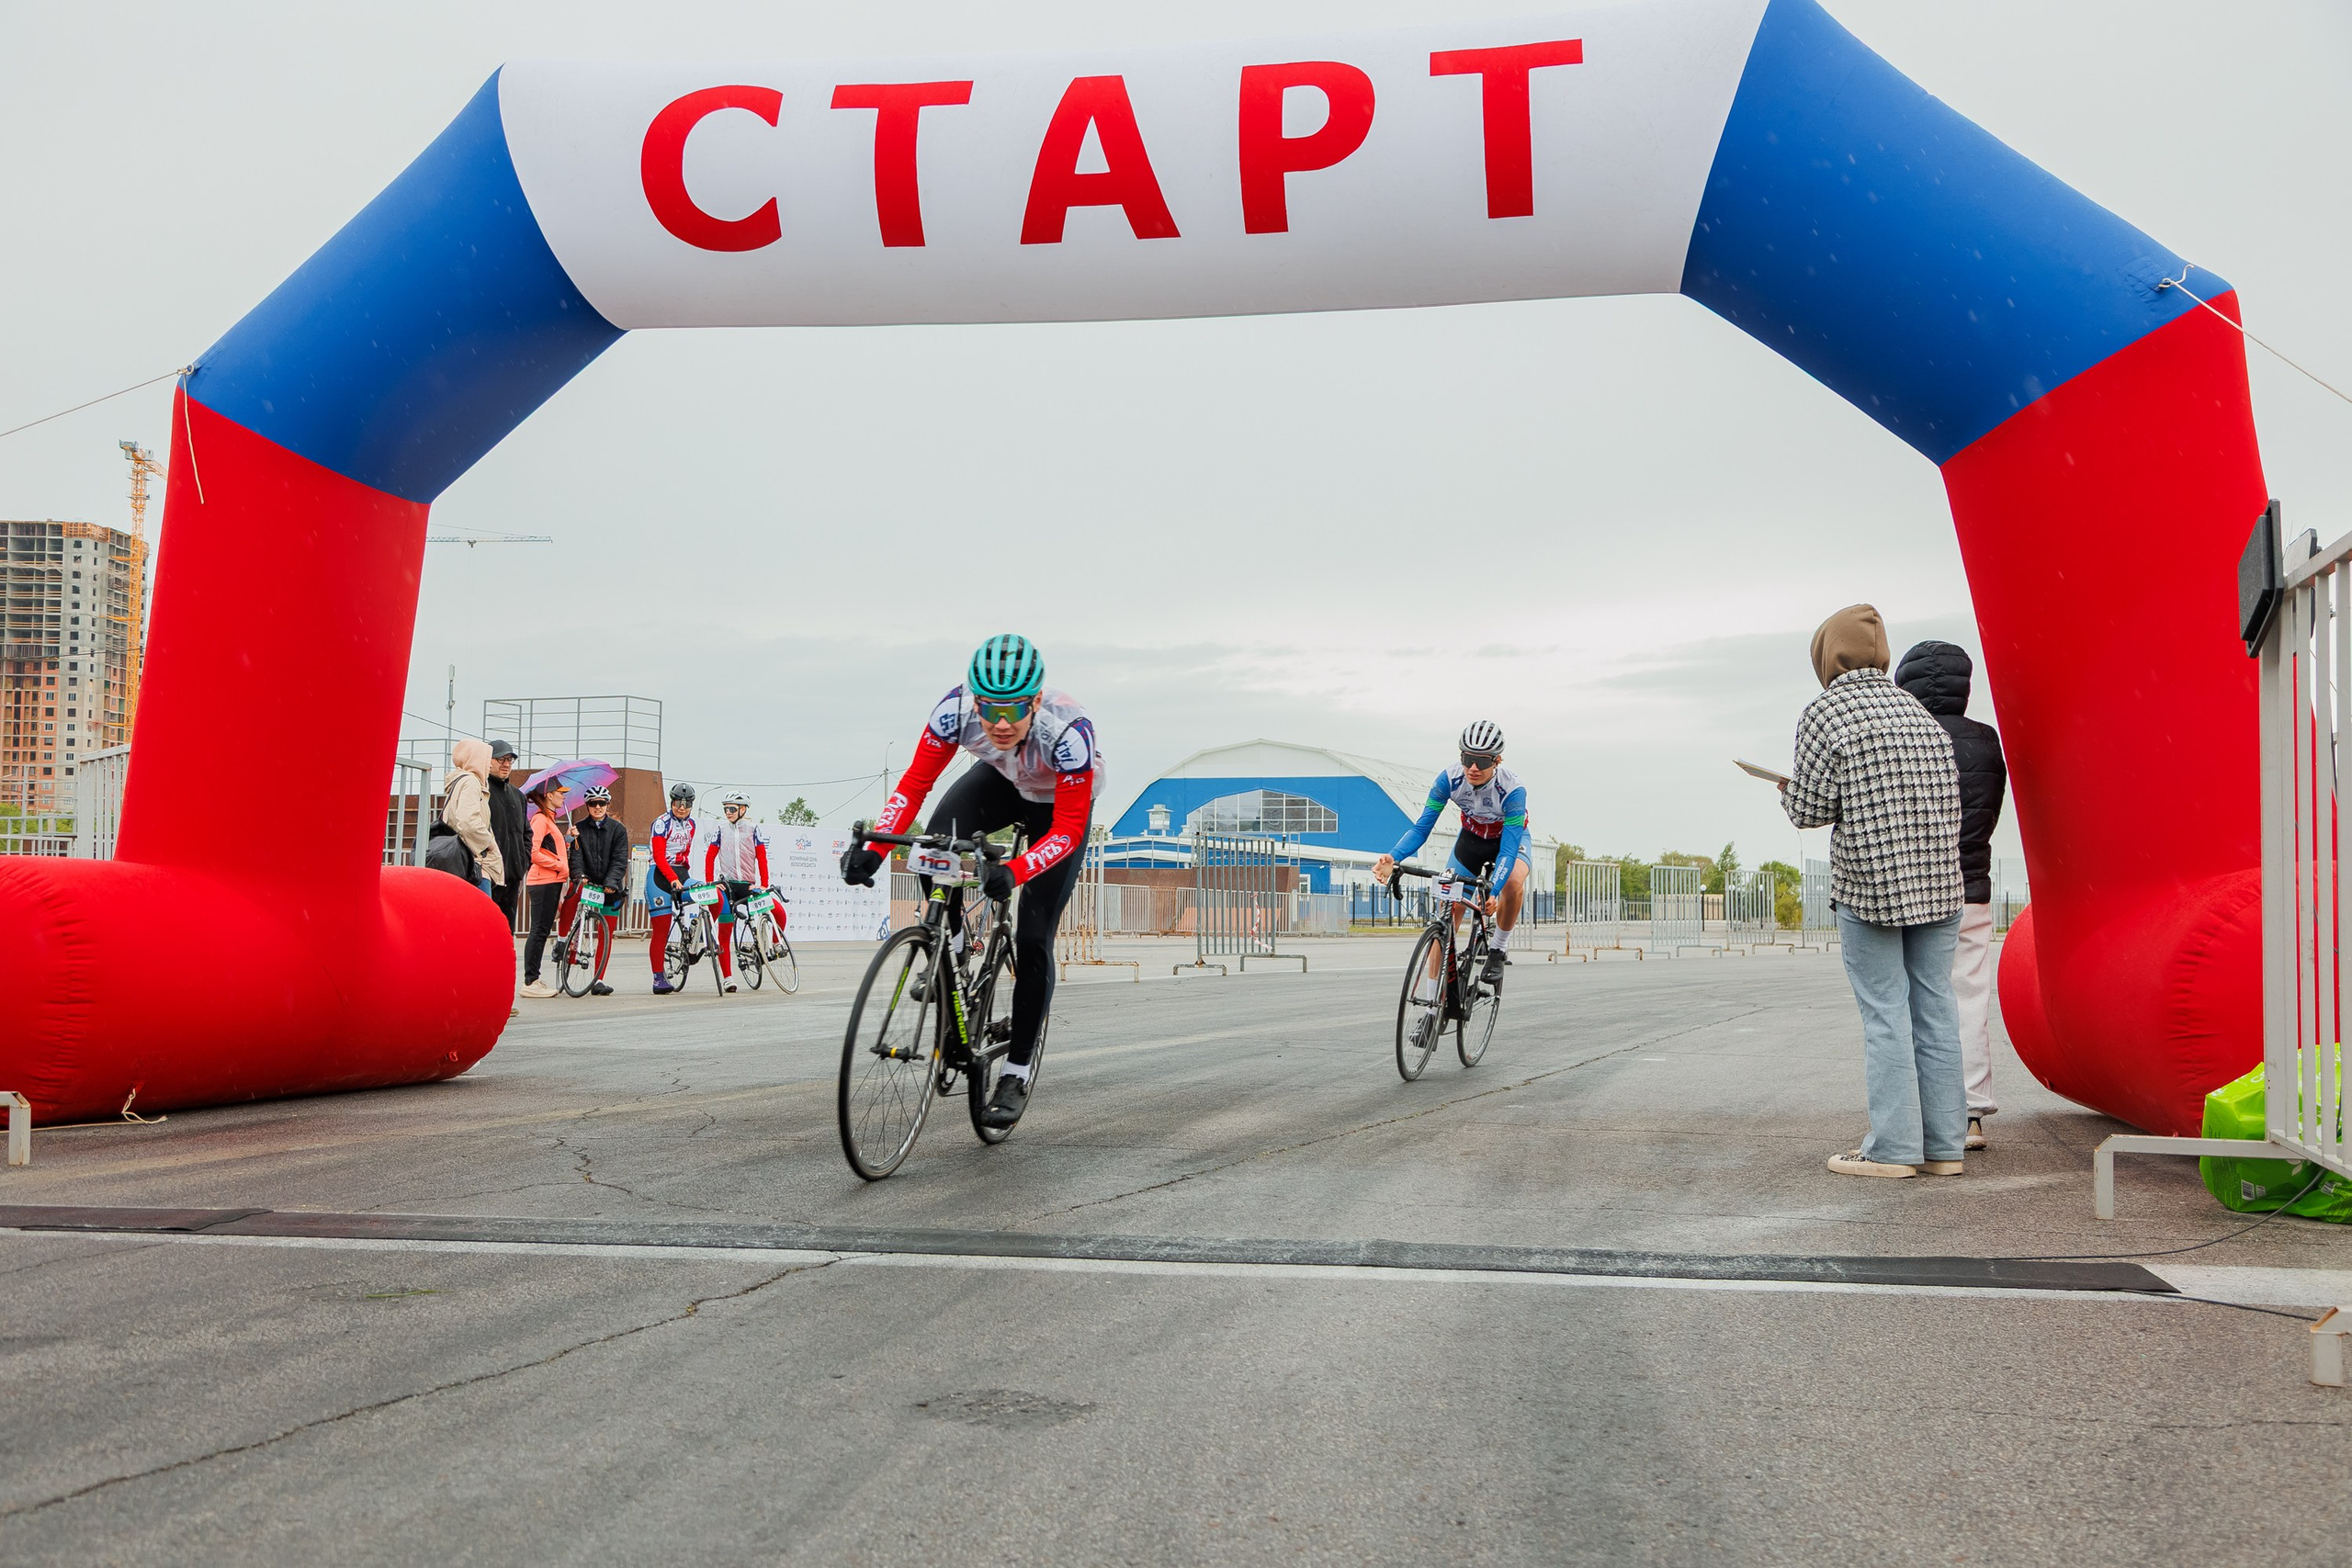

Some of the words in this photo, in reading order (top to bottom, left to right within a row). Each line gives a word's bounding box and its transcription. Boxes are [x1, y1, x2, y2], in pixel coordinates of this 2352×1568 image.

[641, 39, 1582, 251] СТАРТ
[877, 792, 908, 827] Русь
[919, 854, 951, 872] 110
[1025, 843, 1063, 872] Русь
[588, 892, 600, 901] 859
[697, 892, 711, 900] 895
[1441, 884, 1452, 895] 5
[753, 899, 765, 909] 897
